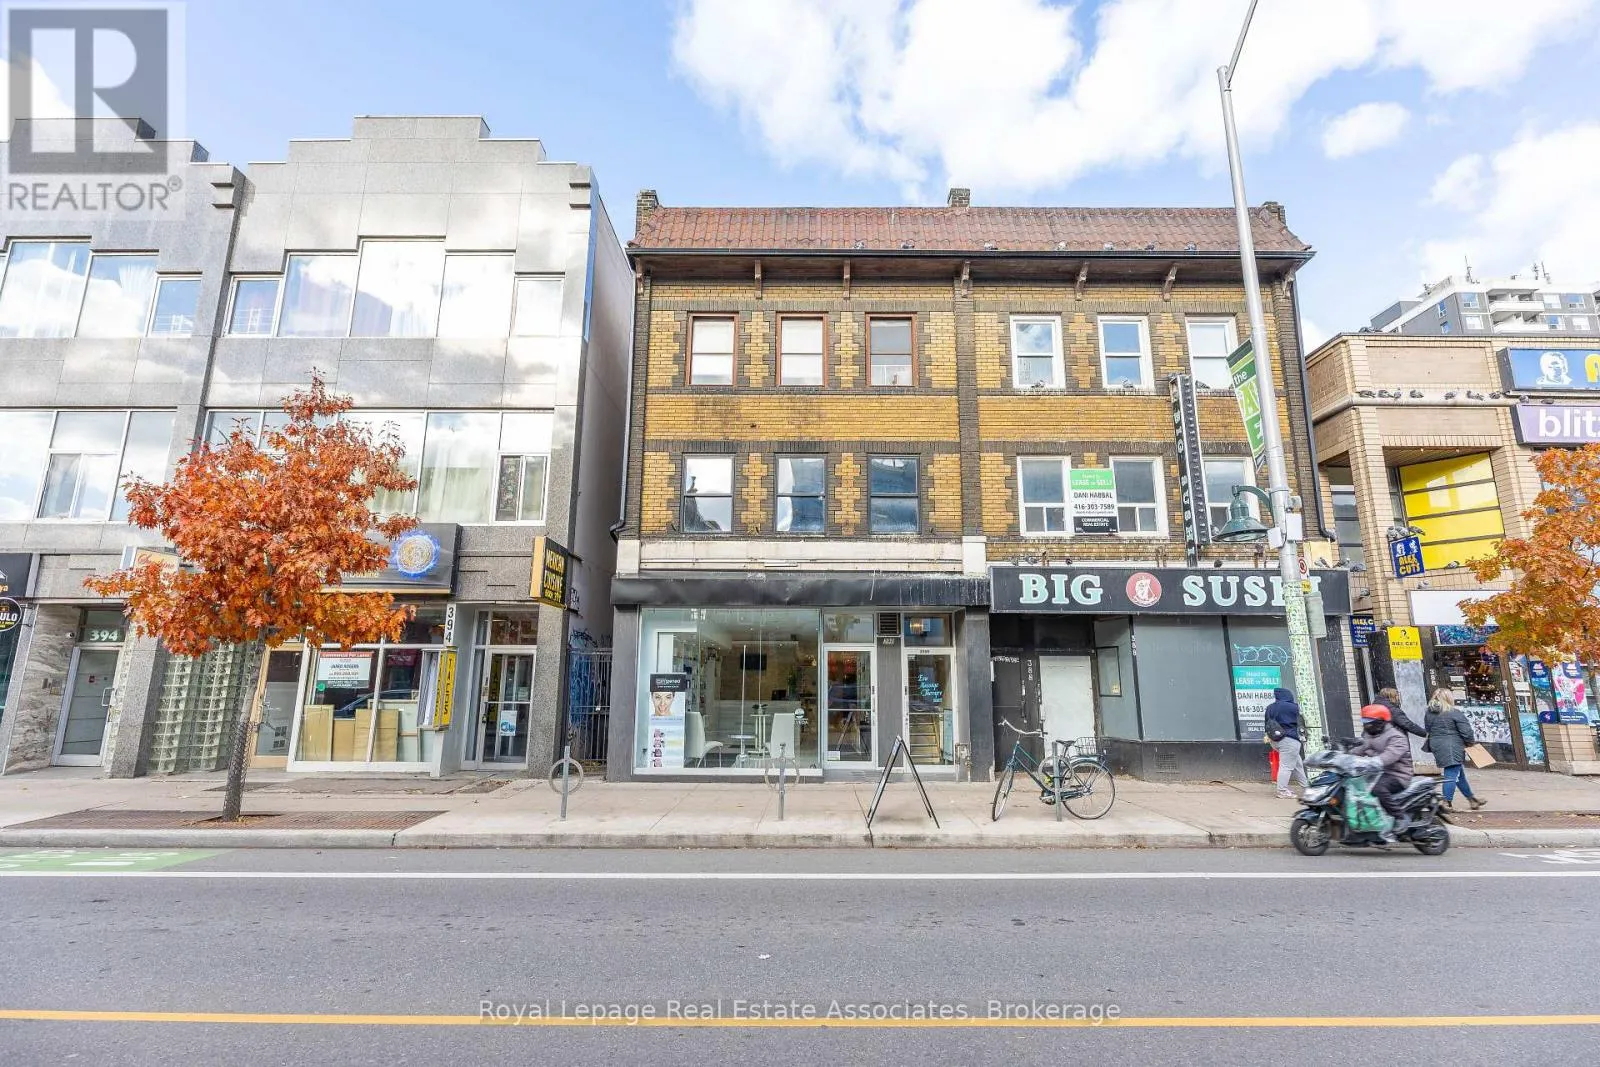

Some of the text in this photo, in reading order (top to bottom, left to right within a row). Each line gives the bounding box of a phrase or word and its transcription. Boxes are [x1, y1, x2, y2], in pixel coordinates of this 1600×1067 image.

[1233, 371, 1248, 387] the
[1018, 573, 1103, 605] BIG
[445, 606, 455, 643] 394
[90, 629, 119, 641] 394
[1235, 677, 1255, 685] LEASE
[1237, 692, 1274, 700] DANI HABB
[1237, 705, 1266, 713] 416-303-
